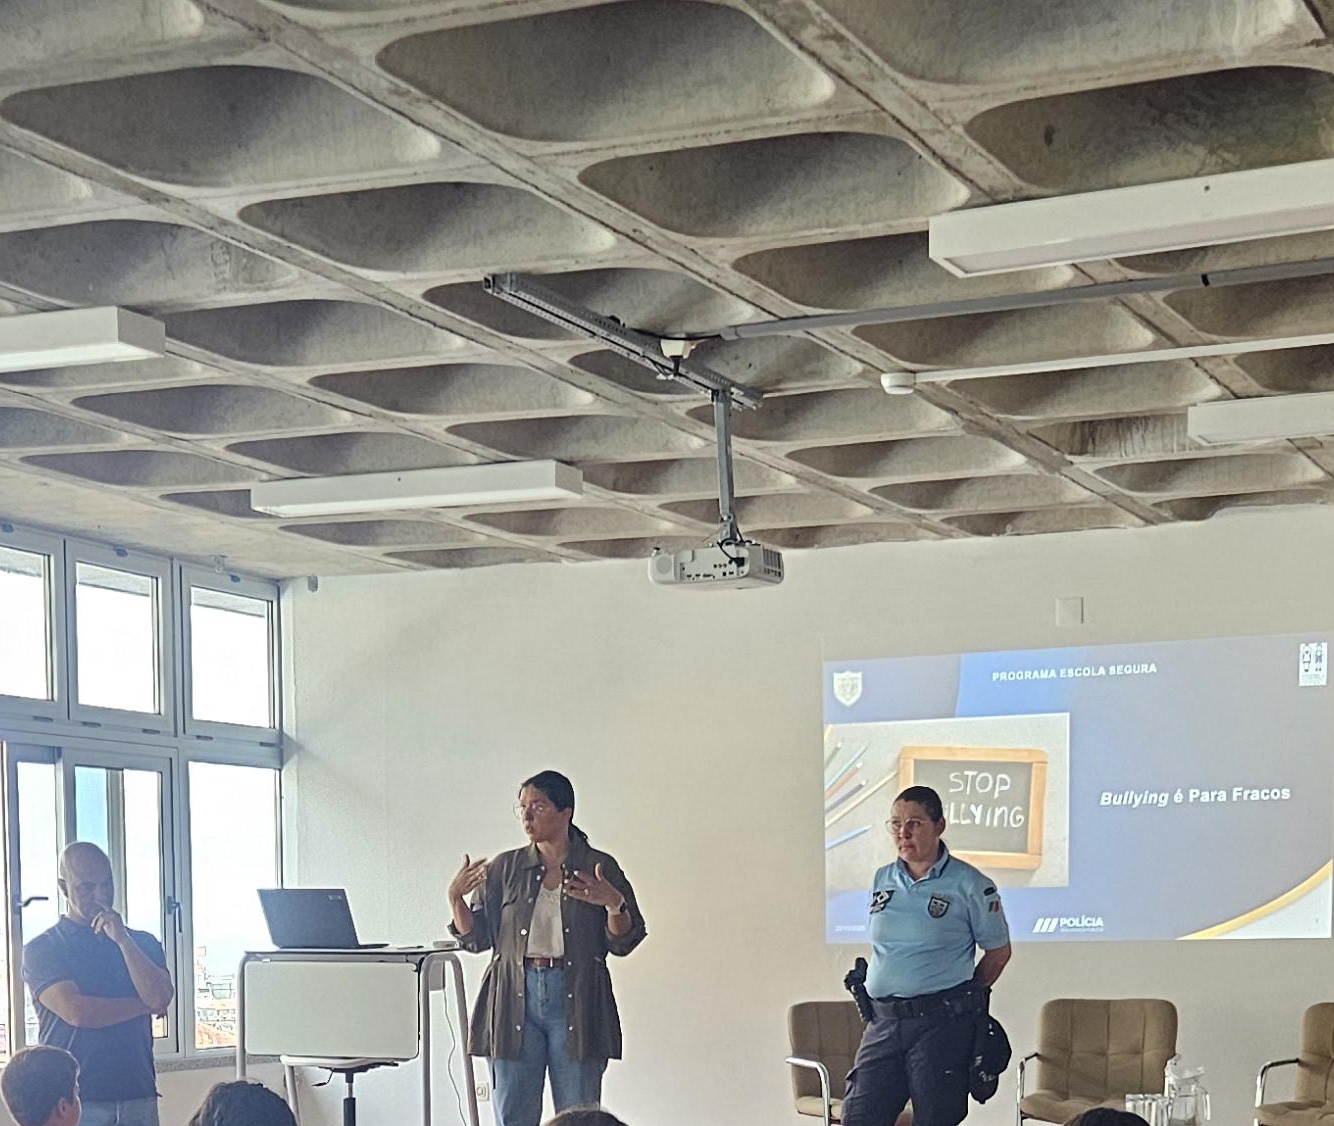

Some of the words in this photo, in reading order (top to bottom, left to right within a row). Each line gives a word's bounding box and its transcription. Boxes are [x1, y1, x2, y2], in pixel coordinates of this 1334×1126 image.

[992, 668, 1057, 682] PROGRAMA
[1059, 666, 1106, 678] ESCOLA
[1108, 663, 1157, 675] SEGURA
[949, 771, 1011, 799] STOP
[1100, 790, 1169, 808] Bullying
[1173, 788, 1184, 803] é
[1189, 789, 1227, 803] Para
[1232, 787, 1291, 801] Fracos
[1060, 915, 1104, 927] POLÍCIA
